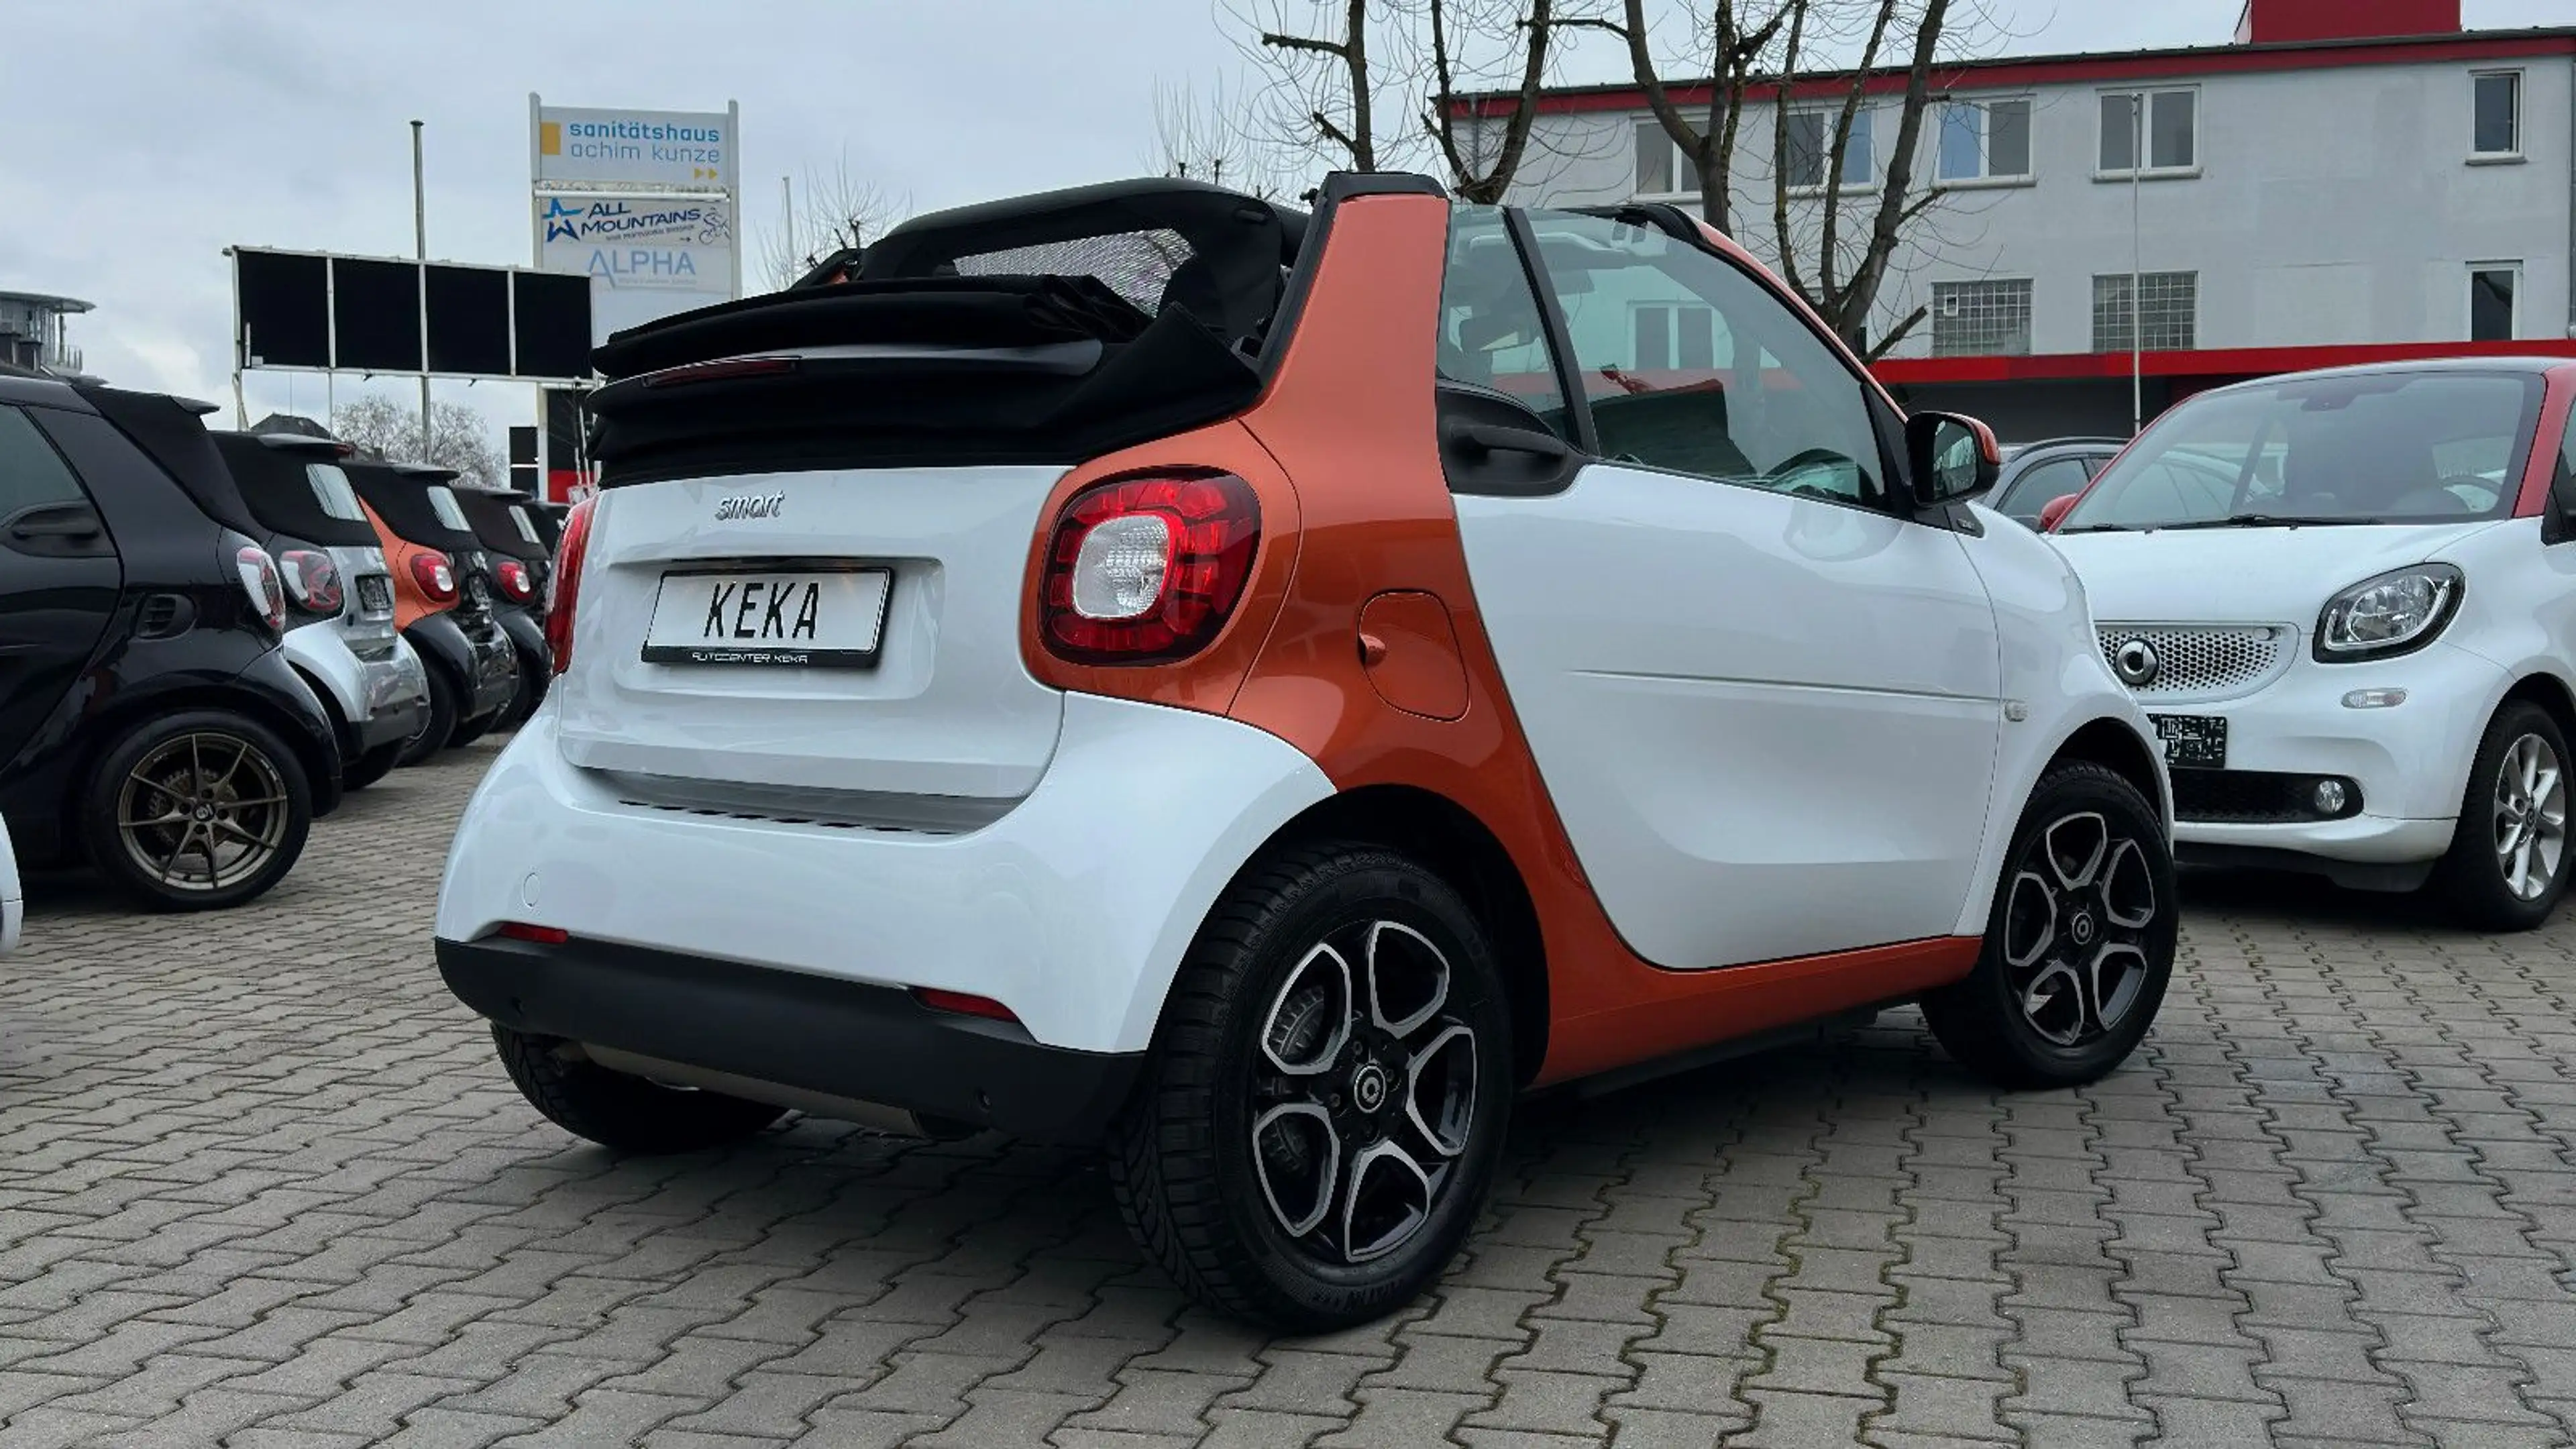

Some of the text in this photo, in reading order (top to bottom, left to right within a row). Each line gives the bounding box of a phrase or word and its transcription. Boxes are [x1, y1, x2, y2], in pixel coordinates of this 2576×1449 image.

[570, 122, 720, 142] sanitätshaus
[572, 142, 720, 163] achim kunze
[580, 209, 701, 235] MOUNTAINS
[588, 202, 631, 219] ALL
[589, 249, 696, 288] ALPHA
[715, 490, 785, 521] smart
[704, 582, 819, 639] KEKA
[773, 654, 808, 664] KEKA
